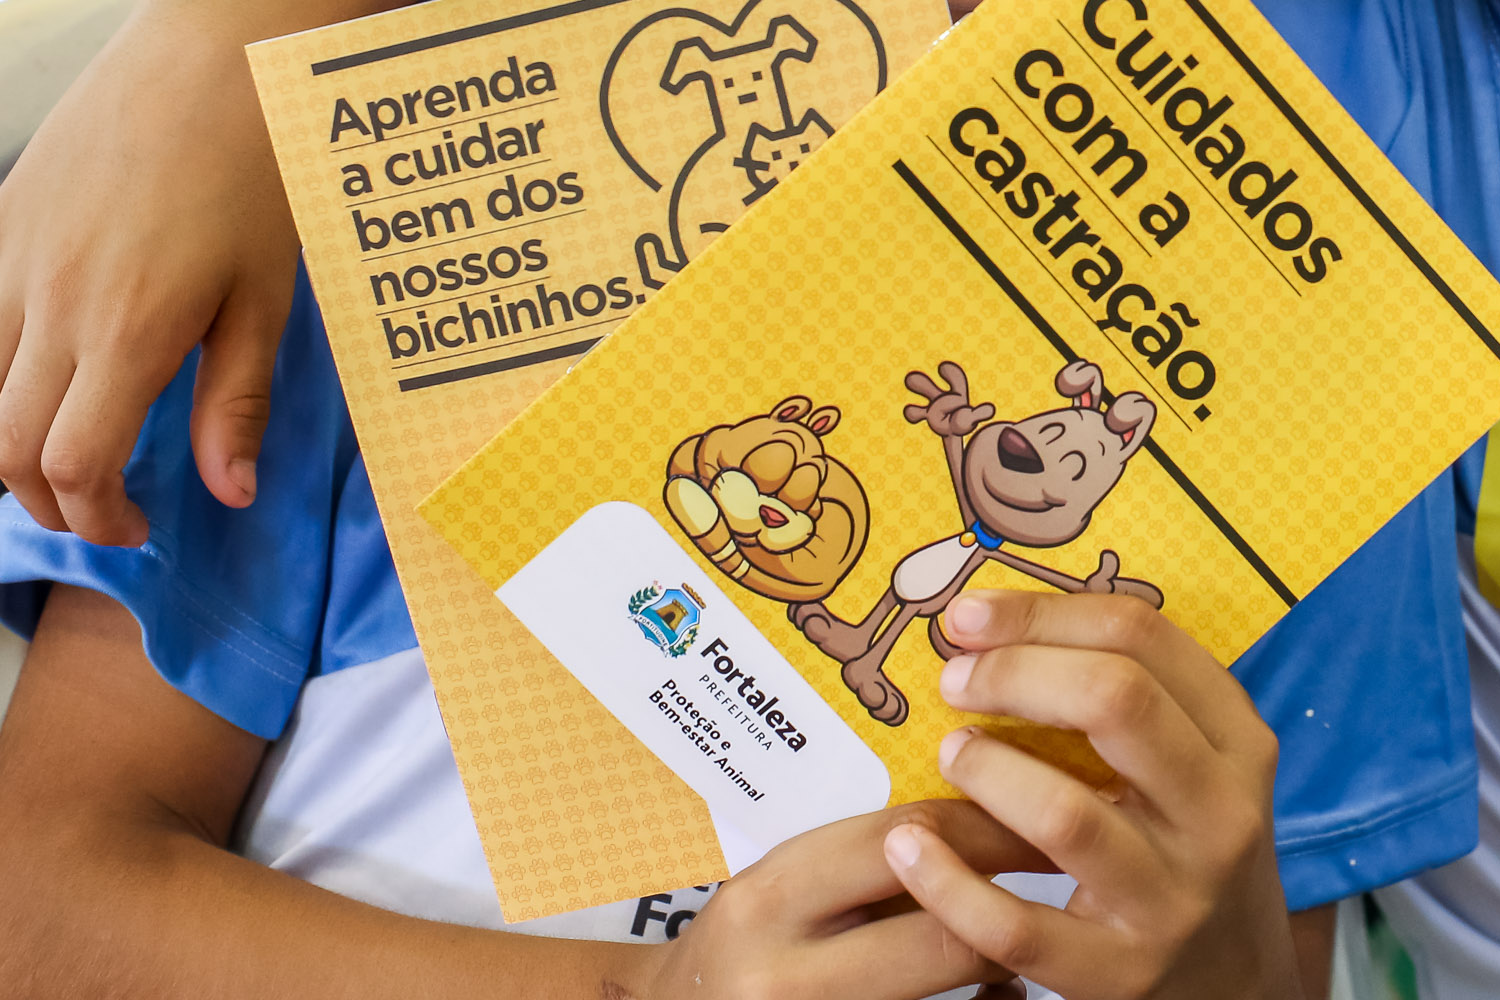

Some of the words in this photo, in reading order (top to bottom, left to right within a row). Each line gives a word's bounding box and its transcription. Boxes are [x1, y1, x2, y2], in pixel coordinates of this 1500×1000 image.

[329, 56, 557, 142] Aprenda
[341, 161, 373, 196] a
[385, 117, 546, 186] cuidar
[1013, 49, 1148, 198] com
[1139, 191, 1191, 248] a
[351, 197, 474, 252] bem
[487, 171, 584, 220] dos
[370, 238, 549, 306] nossos
[948, 107, 1217, 422] castração.
[381, 276, 647, 359] bichinhos.
[662, 679, 721, 740] Proteção
[720, 740, 732, 751] e
[699, 674, 772, 750] PREFEITURA
[700, 637, 808, 752] Fortaleza
[649, 690, 716, 757] Bem-estar
[714, 757, 765, 802] Animal
